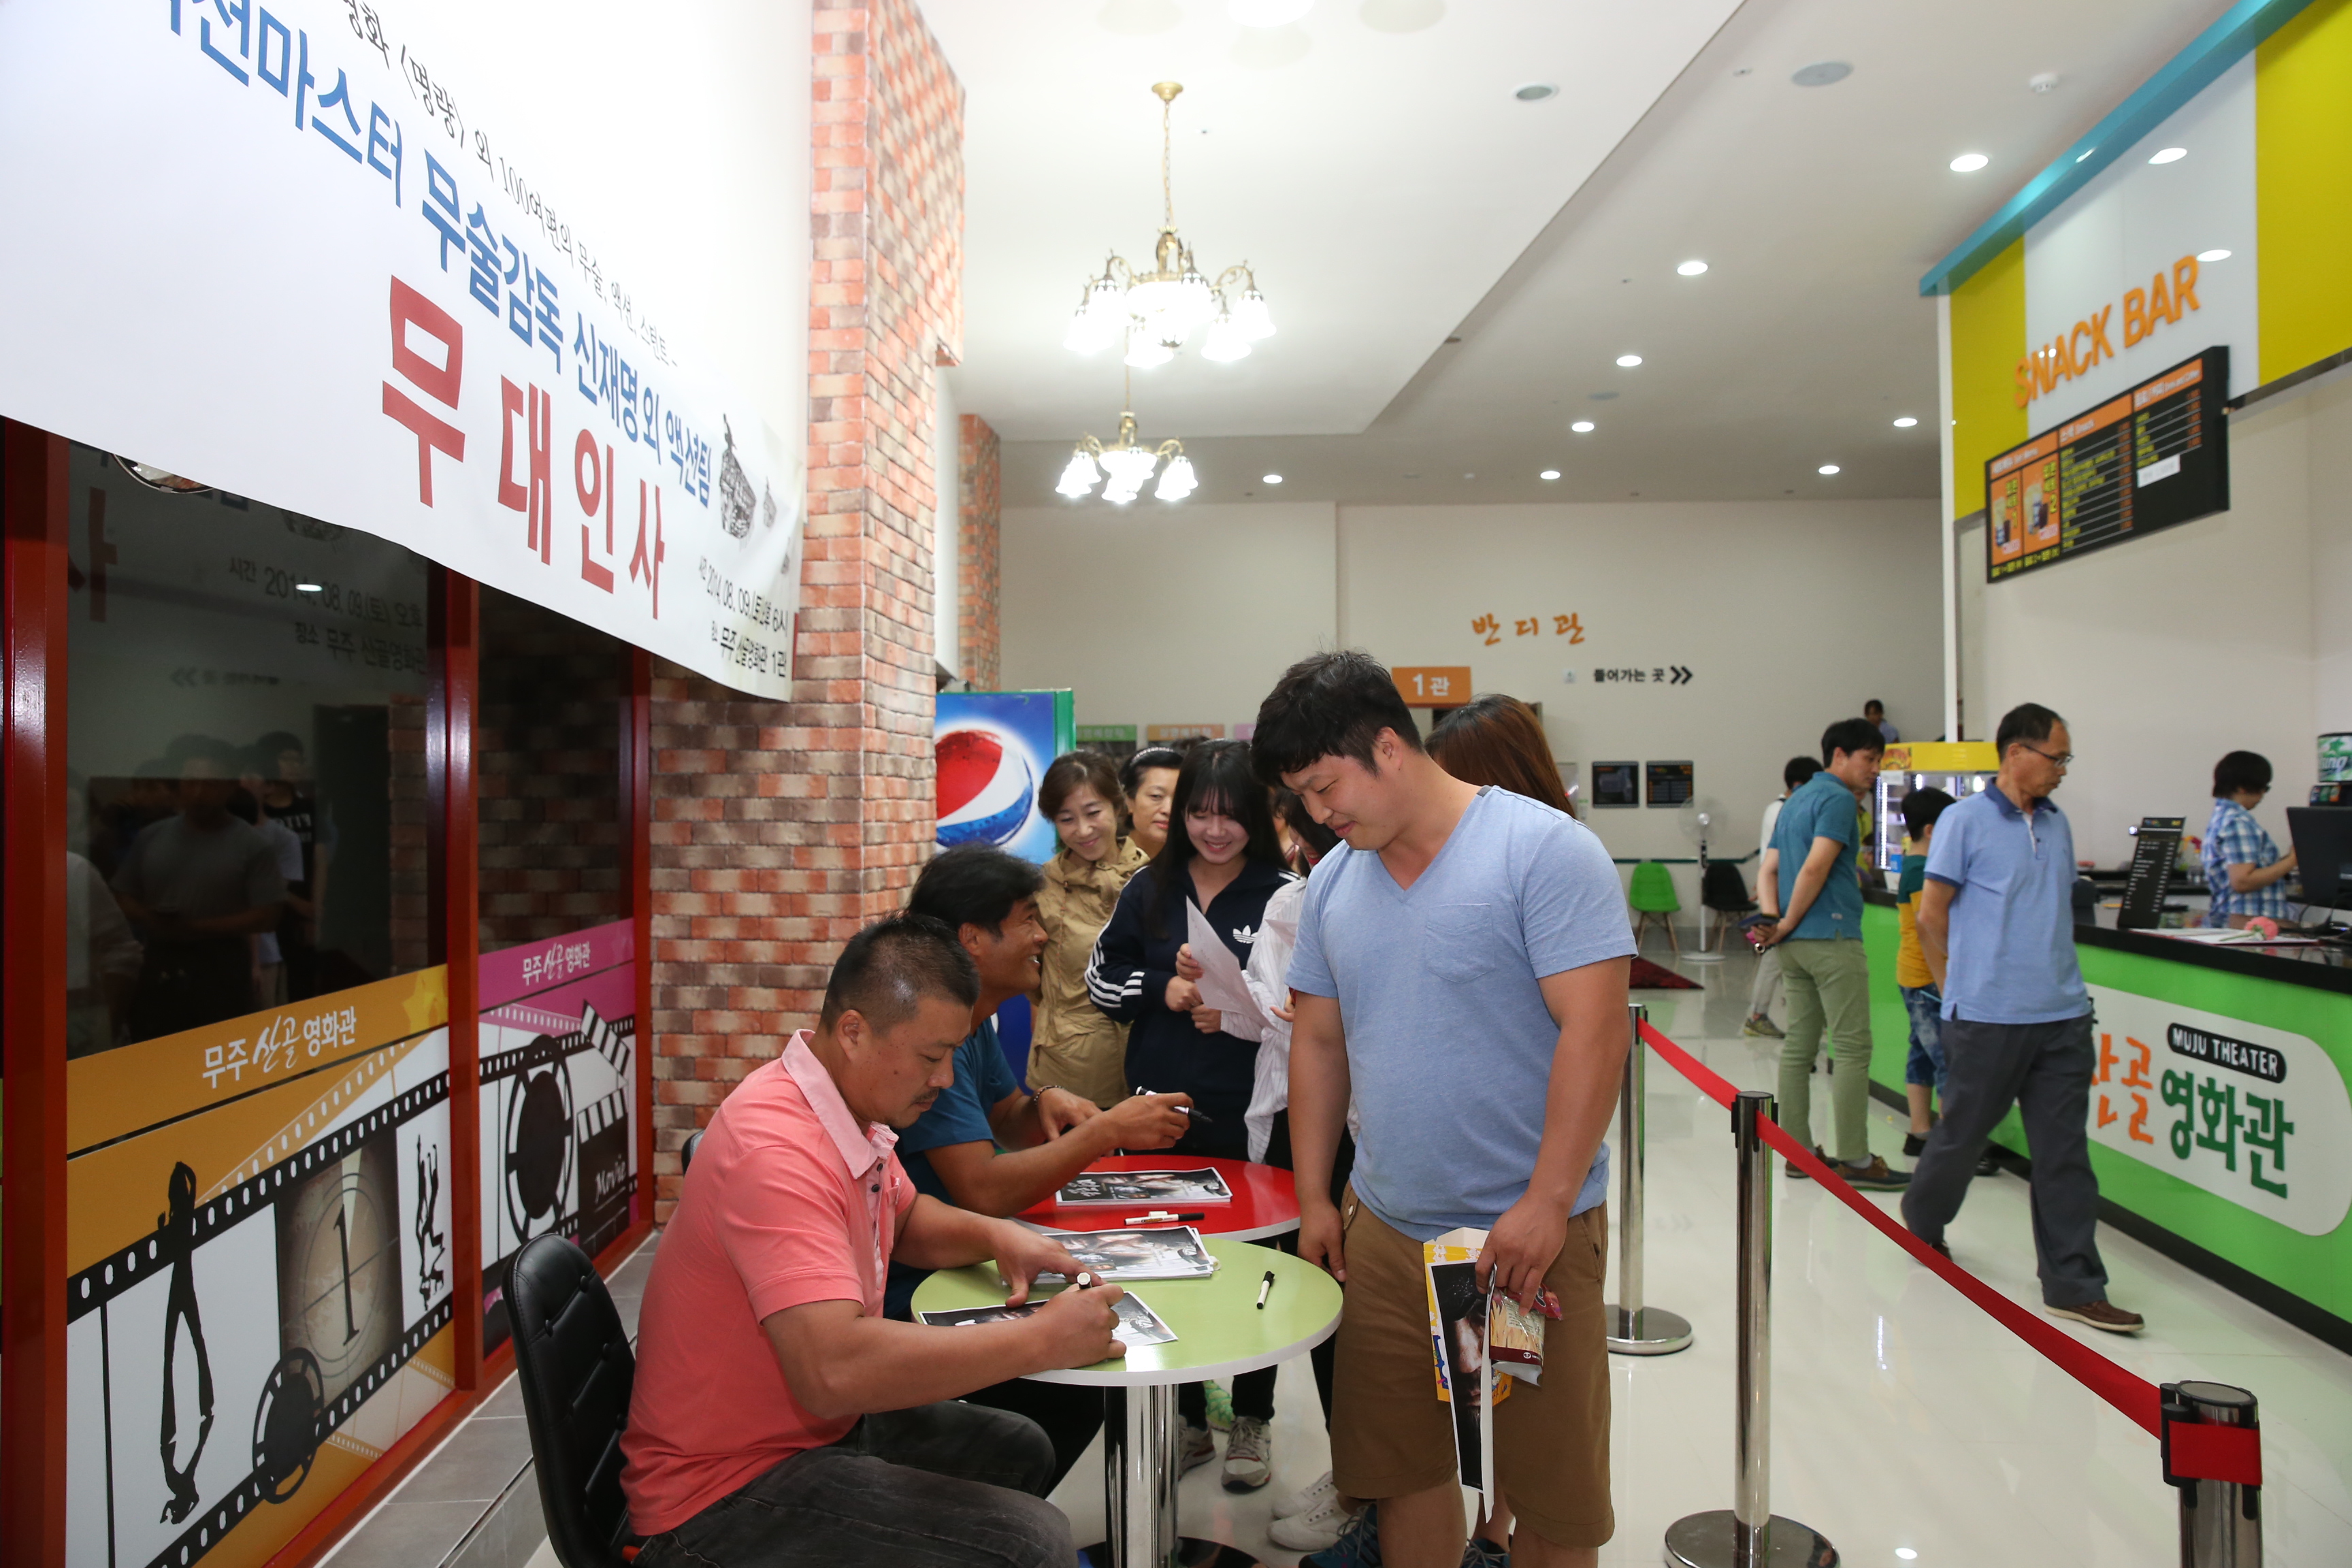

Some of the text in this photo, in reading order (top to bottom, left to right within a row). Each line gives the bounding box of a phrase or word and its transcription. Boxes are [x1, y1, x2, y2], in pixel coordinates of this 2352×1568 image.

[170, 0, 402, 208] 션마스터
[421, 148, 564, 374] 무술감독
[574, 310, 638, 443] 신재명
[666, 410, 712, 508] 액션팀
[2014, 255, 2201, 409] SNACK BAR
[382, 274, 666, 621] 무대인사
[720, 627, 738, 661] 무주
[772, 650, 787, 678] 1관
[1593, 668, 1666, 683] 들어가는 곳
[522, 954, 543, 986] 무주
[566, 941, 591, 973] 영화관
[203, 1038, 249, 1089] 무주
[303, 1005, 357, 1058] 영화관
[2172, 1026, 2278, 1078] MUJU THEATER
[2161, 1068, 2295, 1200] 영화관
